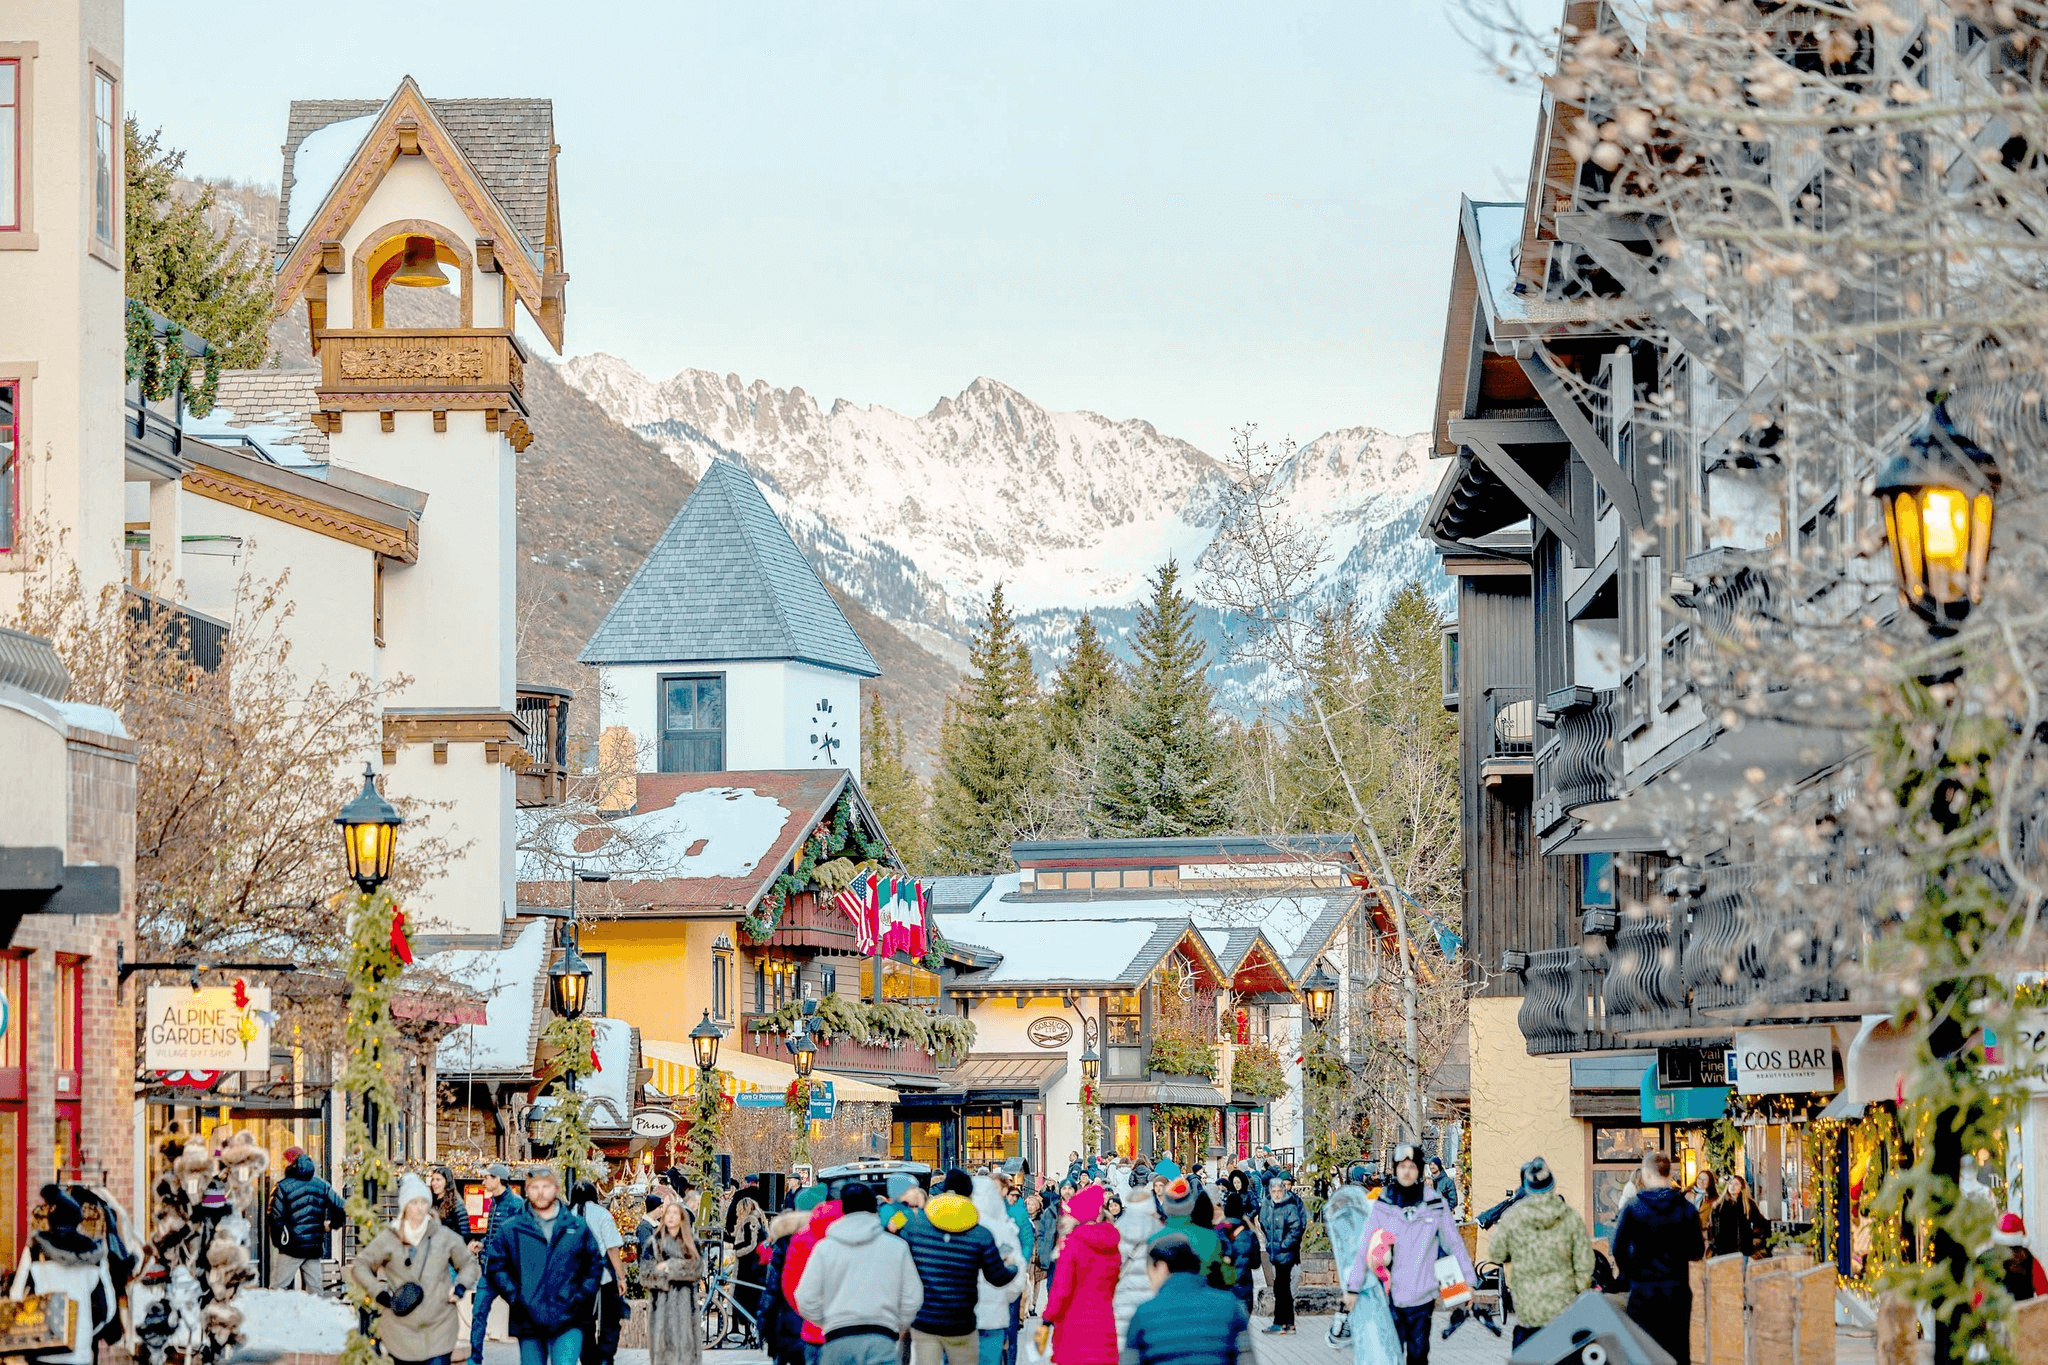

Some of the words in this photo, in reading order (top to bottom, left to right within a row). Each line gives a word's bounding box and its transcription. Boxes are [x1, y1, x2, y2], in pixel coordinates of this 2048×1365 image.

[162, 1006, 226, 1026] ALPINE
[1034, 1021, 1067, 1032] GORSUCH
[151, 1024, 237, 1045] GARDENS
[1699, 1048, 1720, 1060] Vail
[1745, 1050, 1782, 1071] COS
[1788, 1048, 1826, 1069] BAR
[1700, 1060, 1724, 1071] Fine
[1700, 1072, 1725, 1084] Win
